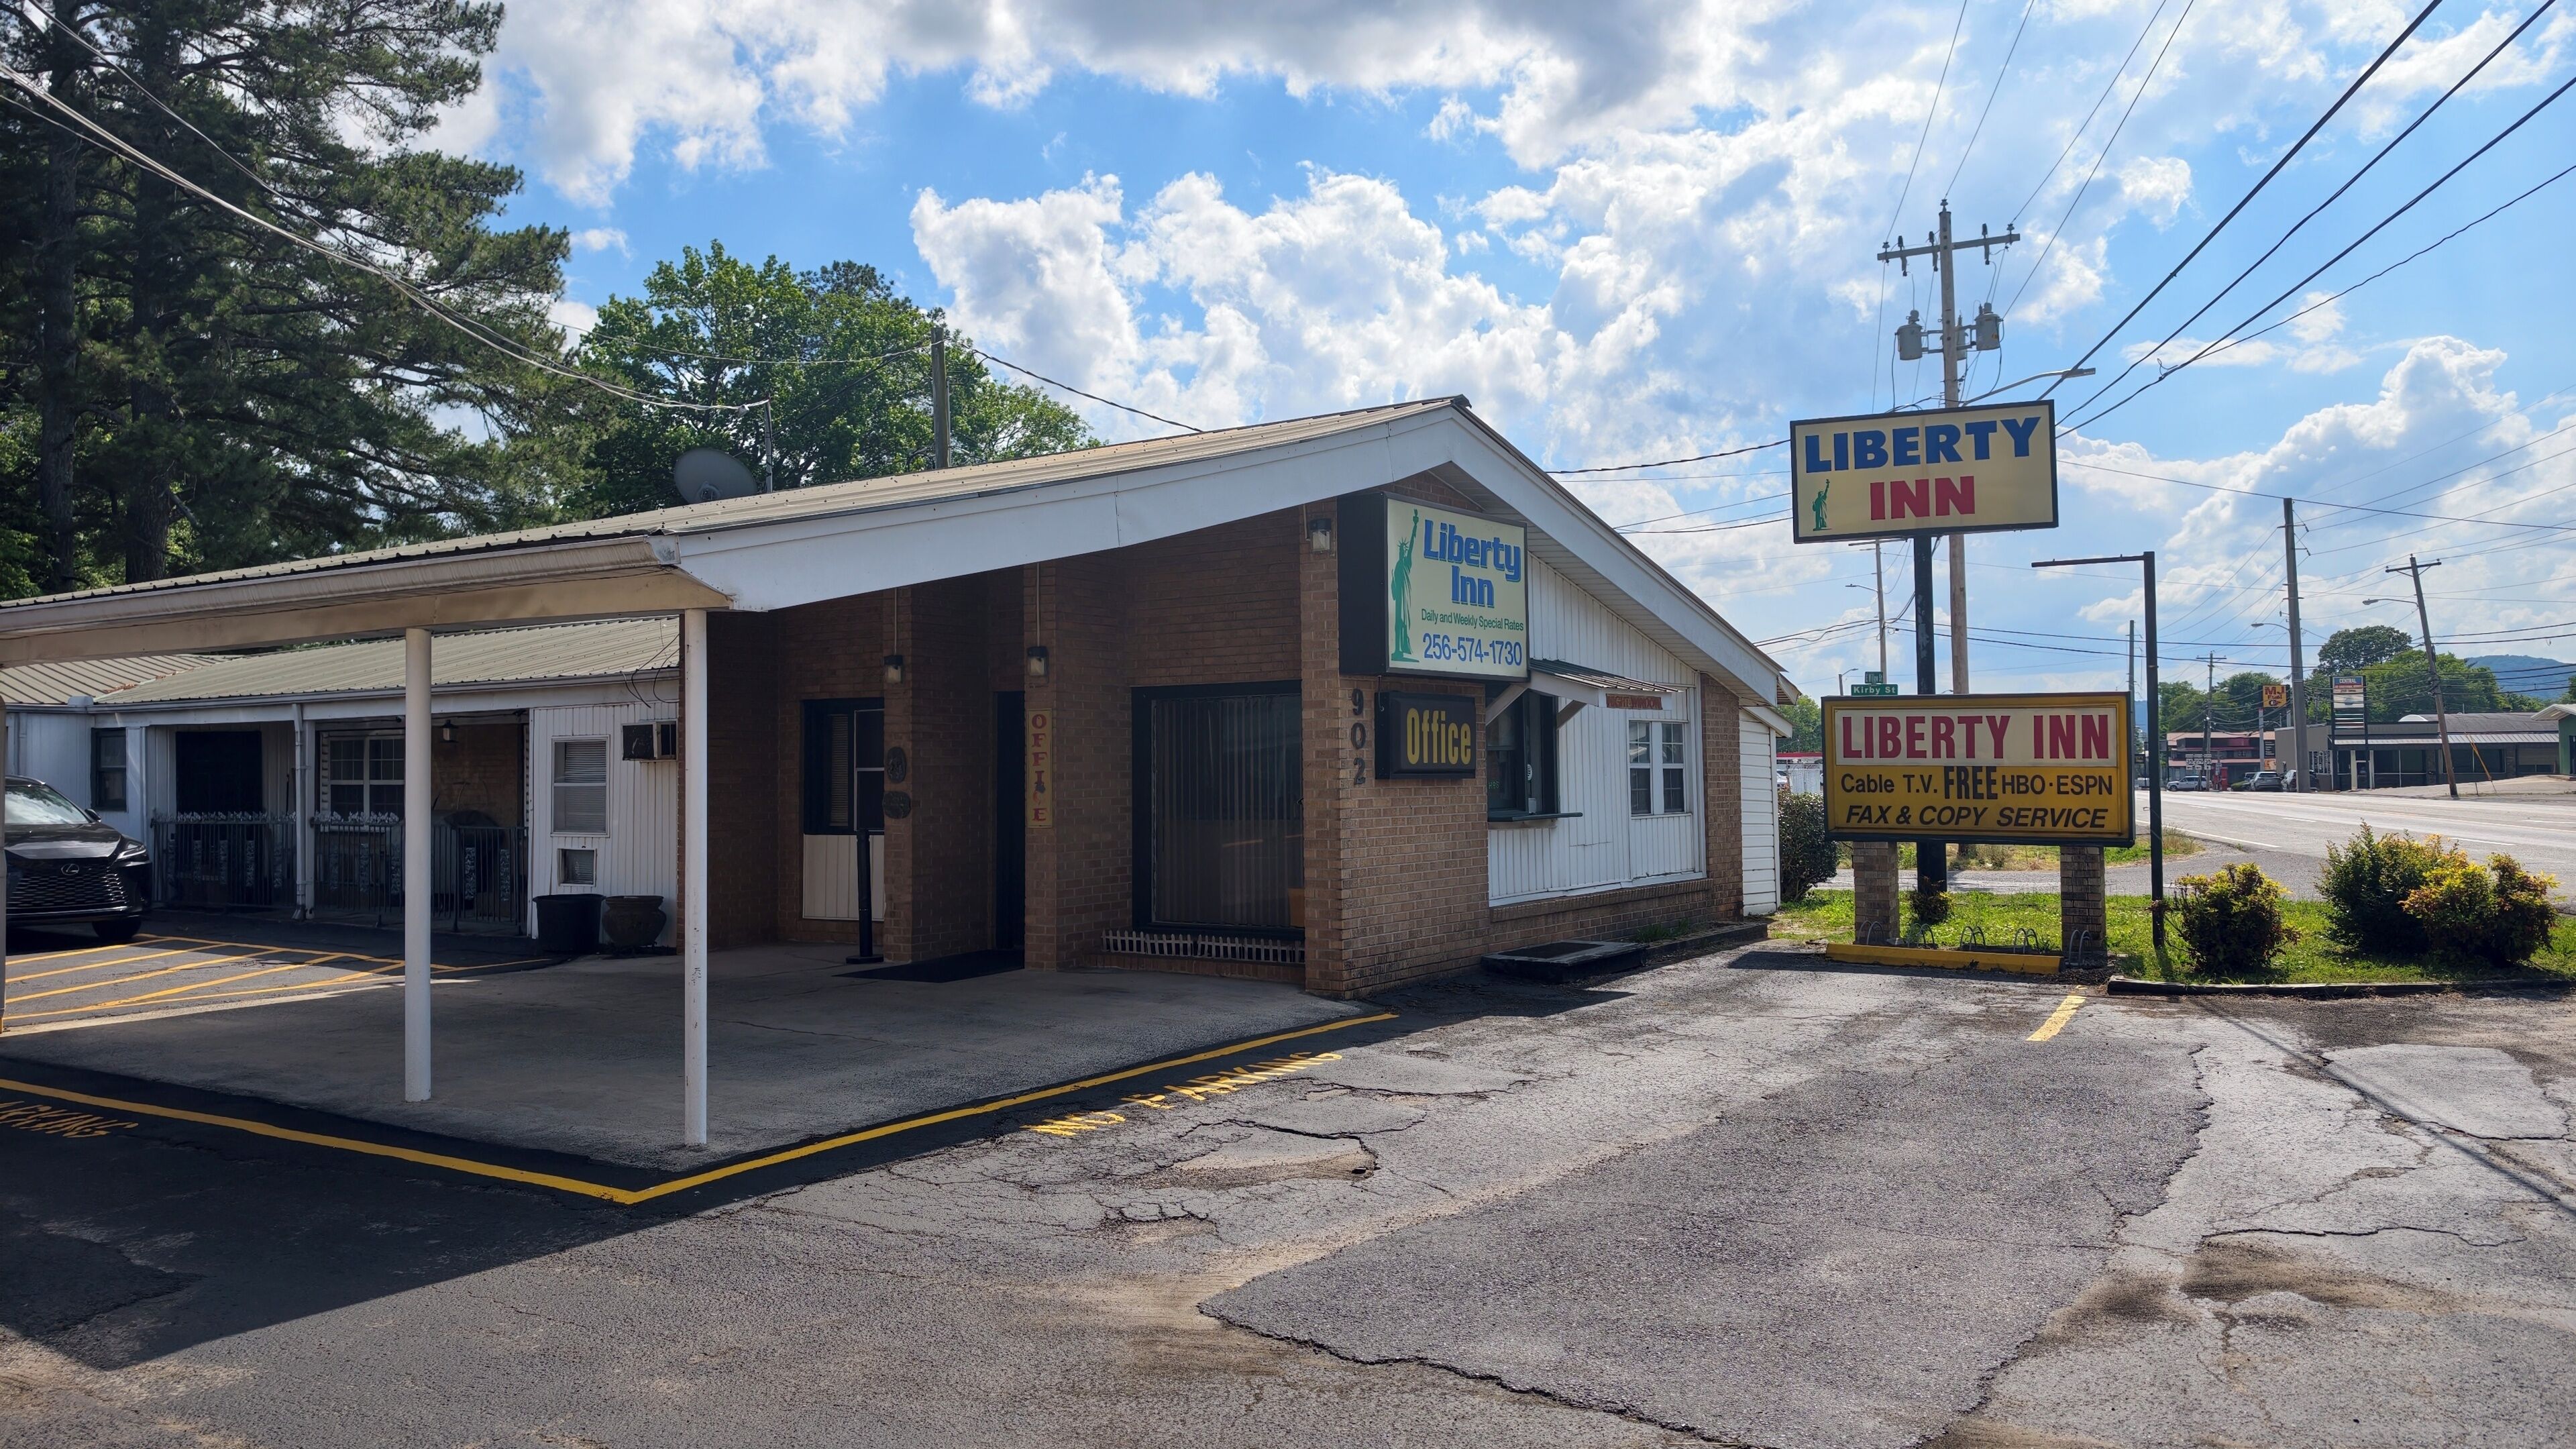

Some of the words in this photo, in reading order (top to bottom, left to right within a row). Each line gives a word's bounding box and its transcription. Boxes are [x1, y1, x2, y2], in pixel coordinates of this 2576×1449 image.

[1805, 417, 2041, 474] LIBERTY
[1870, 476, 1976, 521] INN
[1424, 519, 1521, 583] Liberty
[1452, 566, 1495, 608] Inn
[1421, 608, 1439, 625] Daily
[1440, 612, 1452, 623] and
[1454, 612, 1478, 629] Weekly
[1479, 616, 1503, 630] Special
[1504, 619, 1524, 631] Rates
[1423, 633, 1522, 666] 256-574-1730
[1854, 686, 1880, 694] Kirby
[1351, 688, 1366, 785] 902
[1407, 708, 1471, 764] Office
[1842, 715, 2011, 759] LIBERTY
[2033, 714, 2109, 759] INN
[1841, 773, 1894, 793] Cable
[1903, 774, 1937, 794] T.V.
[1943, 766, 1998, 800] FREE
[1846, 805, 1892, 824] FAX
[1896, 806, 1911, 824] &
[1919, 806, 1988, 825] COPY
[1996, 807, 2108, 828] SERVICE
